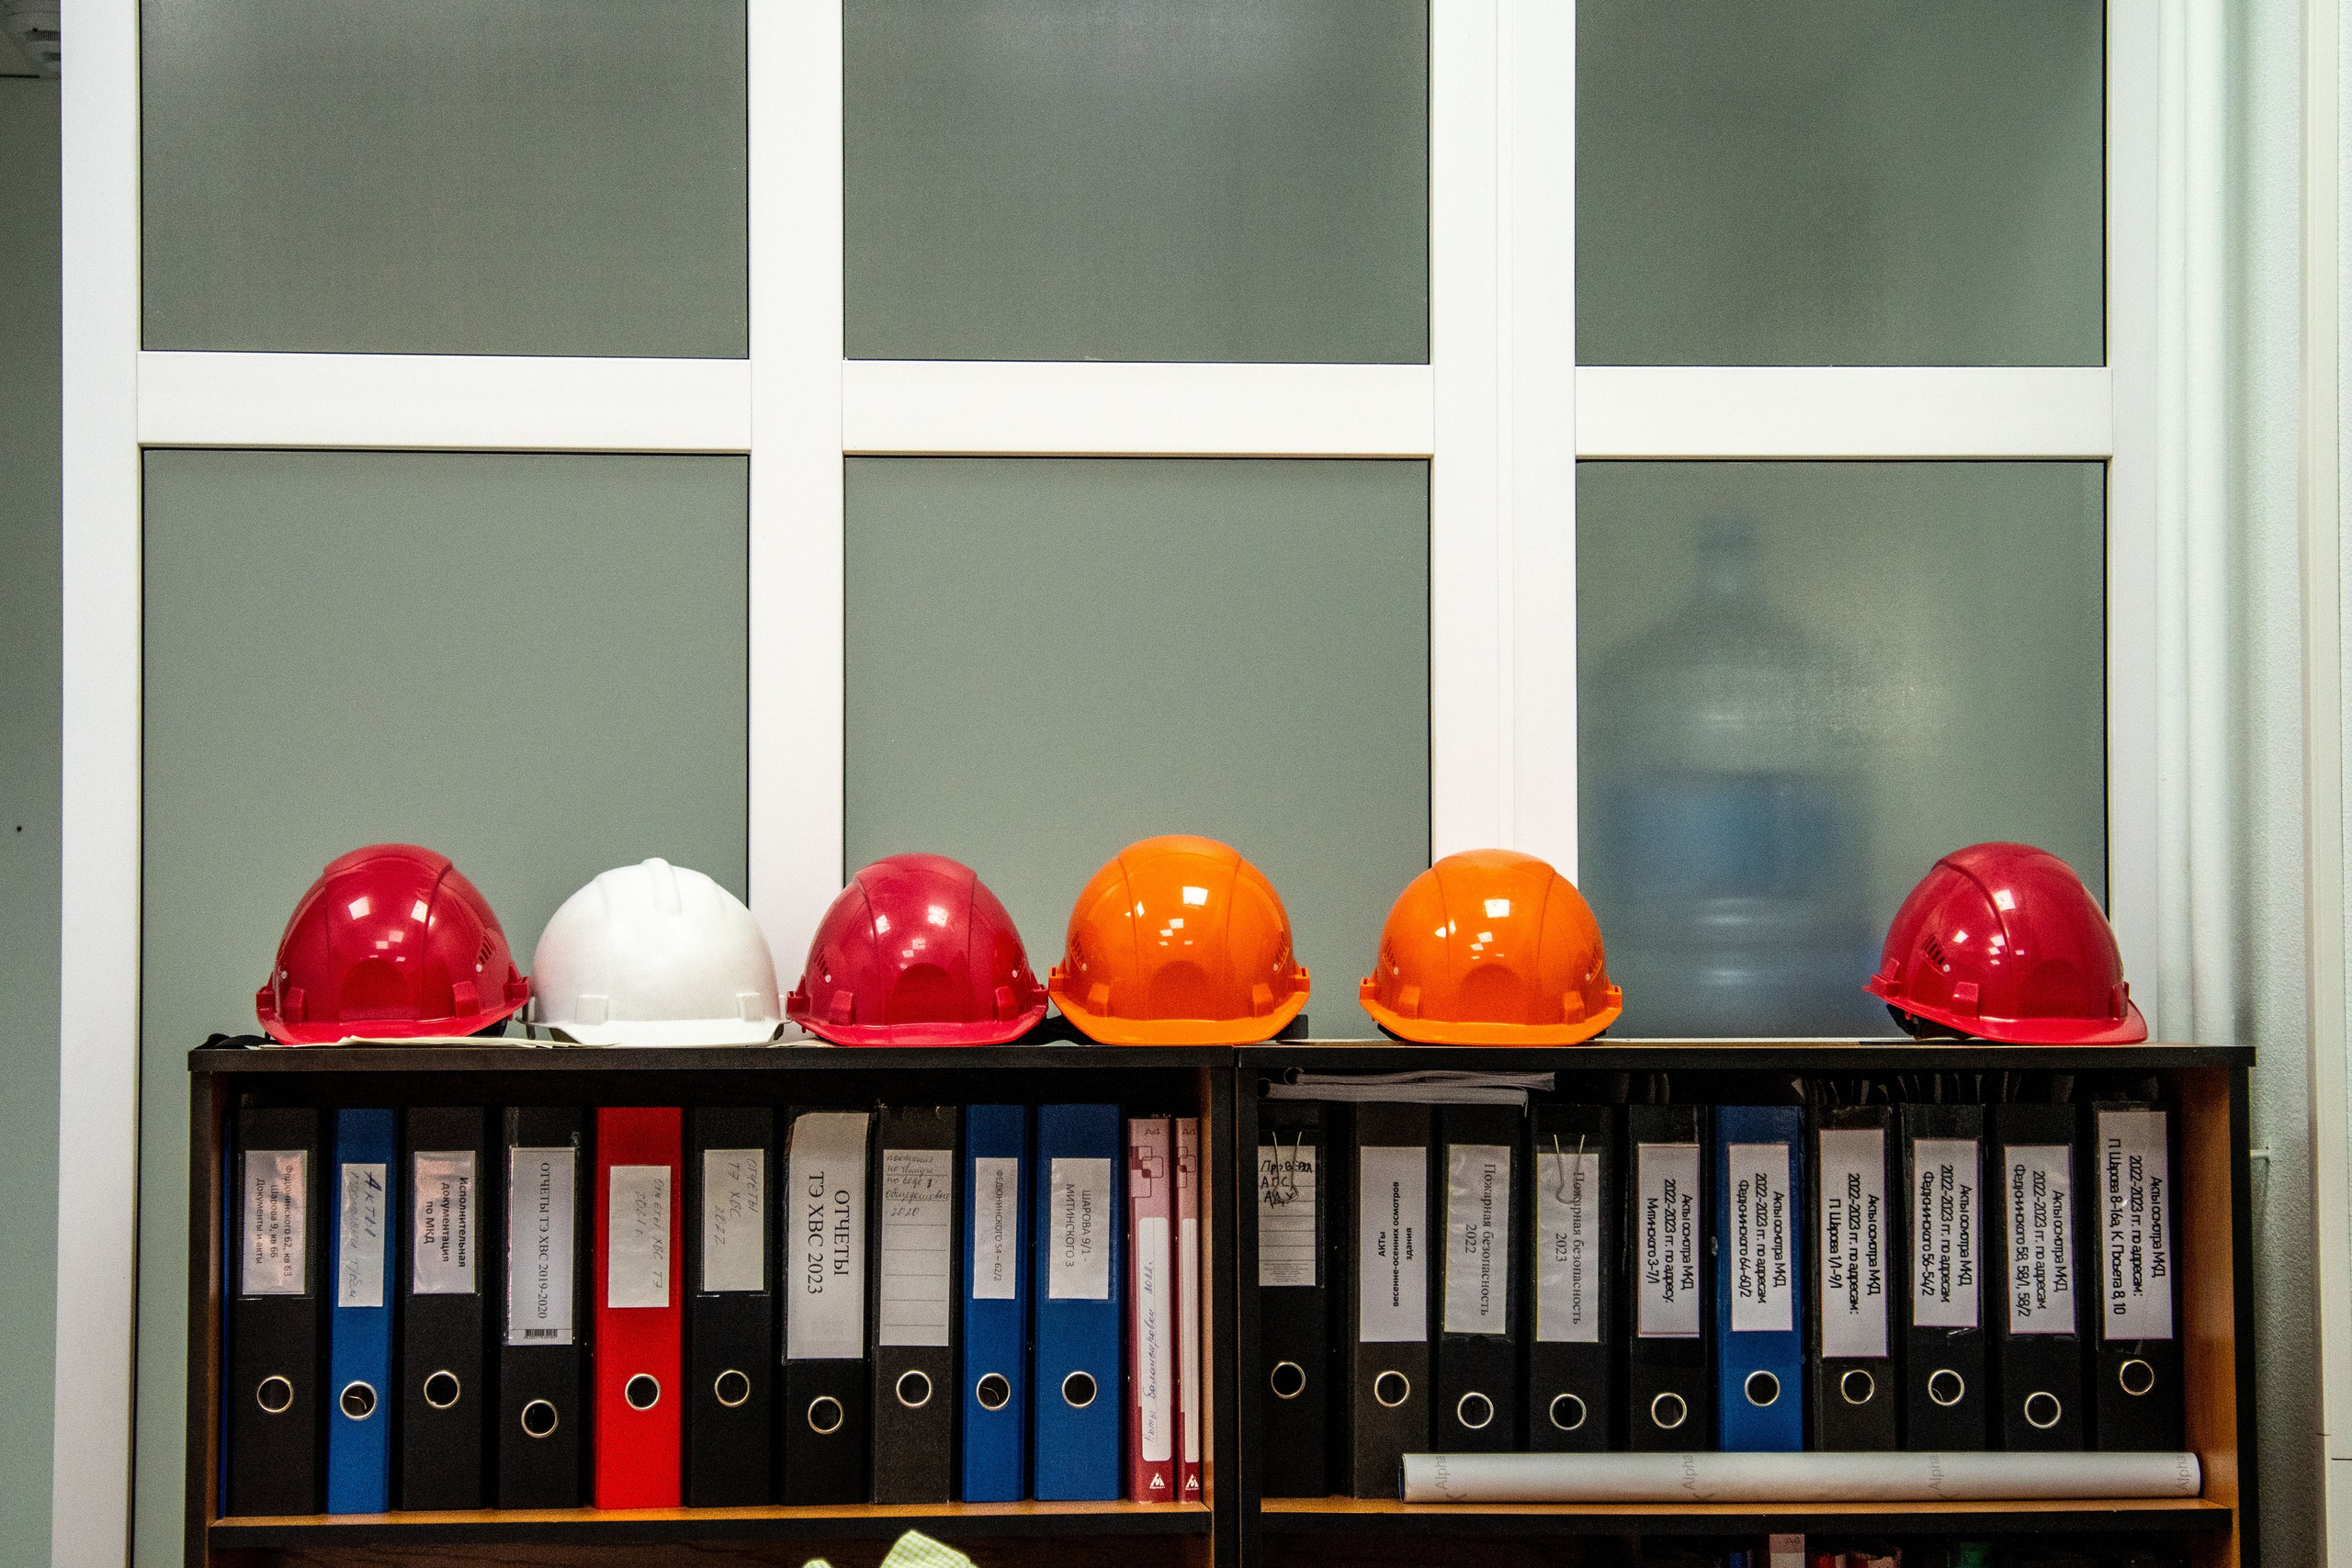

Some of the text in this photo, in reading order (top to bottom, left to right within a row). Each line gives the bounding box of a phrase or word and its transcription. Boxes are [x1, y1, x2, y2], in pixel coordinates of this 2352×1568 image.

[2107, 1152, 2121, 1193] Шарова
[255, 1179, 266, 1231] Документы
[269, 1185, 278, 1258] Шарова 9, кв 66
[424, 1201, 435, 1244] по МКД
[440, 1182, 450, 1262] документация
[458, 1177, 469, 1267] Исполнительная
[635, 1190, 647, 1225] 2021
[714, 1205, 726, 1247] 2022
[890, 1207, 920, 1217] 2020
[994, 1170, 1003, 1242] ФЕДЮНИНСКОГО
[1065, 1183, 1075, 1258] МИТИНСКОГО
[1081, 1190, 1091, 1235] ШАРОВА
[1664, 1179, 1677, 1233] 2022-2023
[2109, 1195, 2124, 1227] 8-16а,
[2130, 1156, 2143, 1296] 2022-2023 гг. по адресам:
[2149, 1176, 2165, 1278] Акты осмотра МКД
[282, 1236, 293, 1250] 62,
[284, 1253, 291, 1263] кв
[537, 1162, 550, 1318] ОТЧЕТЫ ТЭ ХВС 2019-2020
[808, 1171, 824, 1294] ТЭ ХВС 2023
[834, 1190, 850, 1276] ОТЧЕТЫ
[995, 1244, 1002, 1254] 54
[1080, 1237, 1091, 1255] 9/1
[1392, 1181, 1401, 1307] весенне-осенних осмотров
[1406, 1227, 1414, 1260] здания
[1465, 1224, 1477, 1254] 2022
[1480, 1164, 1496, 1315] Пожарная безопасность
[1555, 1233, 1567, 1262] 2023
[1570, 1171, 1585, 1325] Пожарная безопасность
[1645, 1198, 1660, 1284] Митинского 3-7/1
[1665, 1235, 1674, 1247] гг.
[1665, 1249, 1674, 1263] по
[1679, 1194, 1694, 1291] Акты осмотра МКД
[1737, 1179, 1752, 1298] Федюнинского 64-60/2
[1755, 1173, 1768, 1303] 2022-2023 гг. по адресам
[1771, 1191, 1787, 1288] Акты осмотра МКД
[1827, 1213, 1841, 1254] Шарова
[1847, 1173, 1860, 1314] 2022-2023 гг. по адресам:
[1865, 1194, 1881, 1295] Акты осмотра МКД
[1921, 1171, 1935, 1296] Федюнинского 56-54/2
[1939, 1164, 1953, 1303] 2022-2023 гг. по адресам
[1957, 1184, 1973, 1286] Акты осмотра МКД
[2013, 1164, 2032, 1316] Федюнинского 58, 58/1, 58/2
[2033, 1170, 2047, 1309] 2022-2023 гг. по адресам
[2052, 1190, 2068, 1292] Акты осмотра МКД
[284, 1266, 292, 1277] 63
[993, 1262, 1002, 1281] 62/2
[1828, 1256, 1842, 1289] 1/1-9/1
[2112, 1245, 2125, 1288] Посьета
[2111, 1291, 2126, 1300] 8,
[2113, 1303, 2127, 1314] 10
[1435, 1456, 1451, 1490] Alpha
[1682, 1455, 1698, 1491] Alpha
[1928, 1454, 1944, 1491] Alpha
[2177, 1455, 2192, 1491] Alpha
